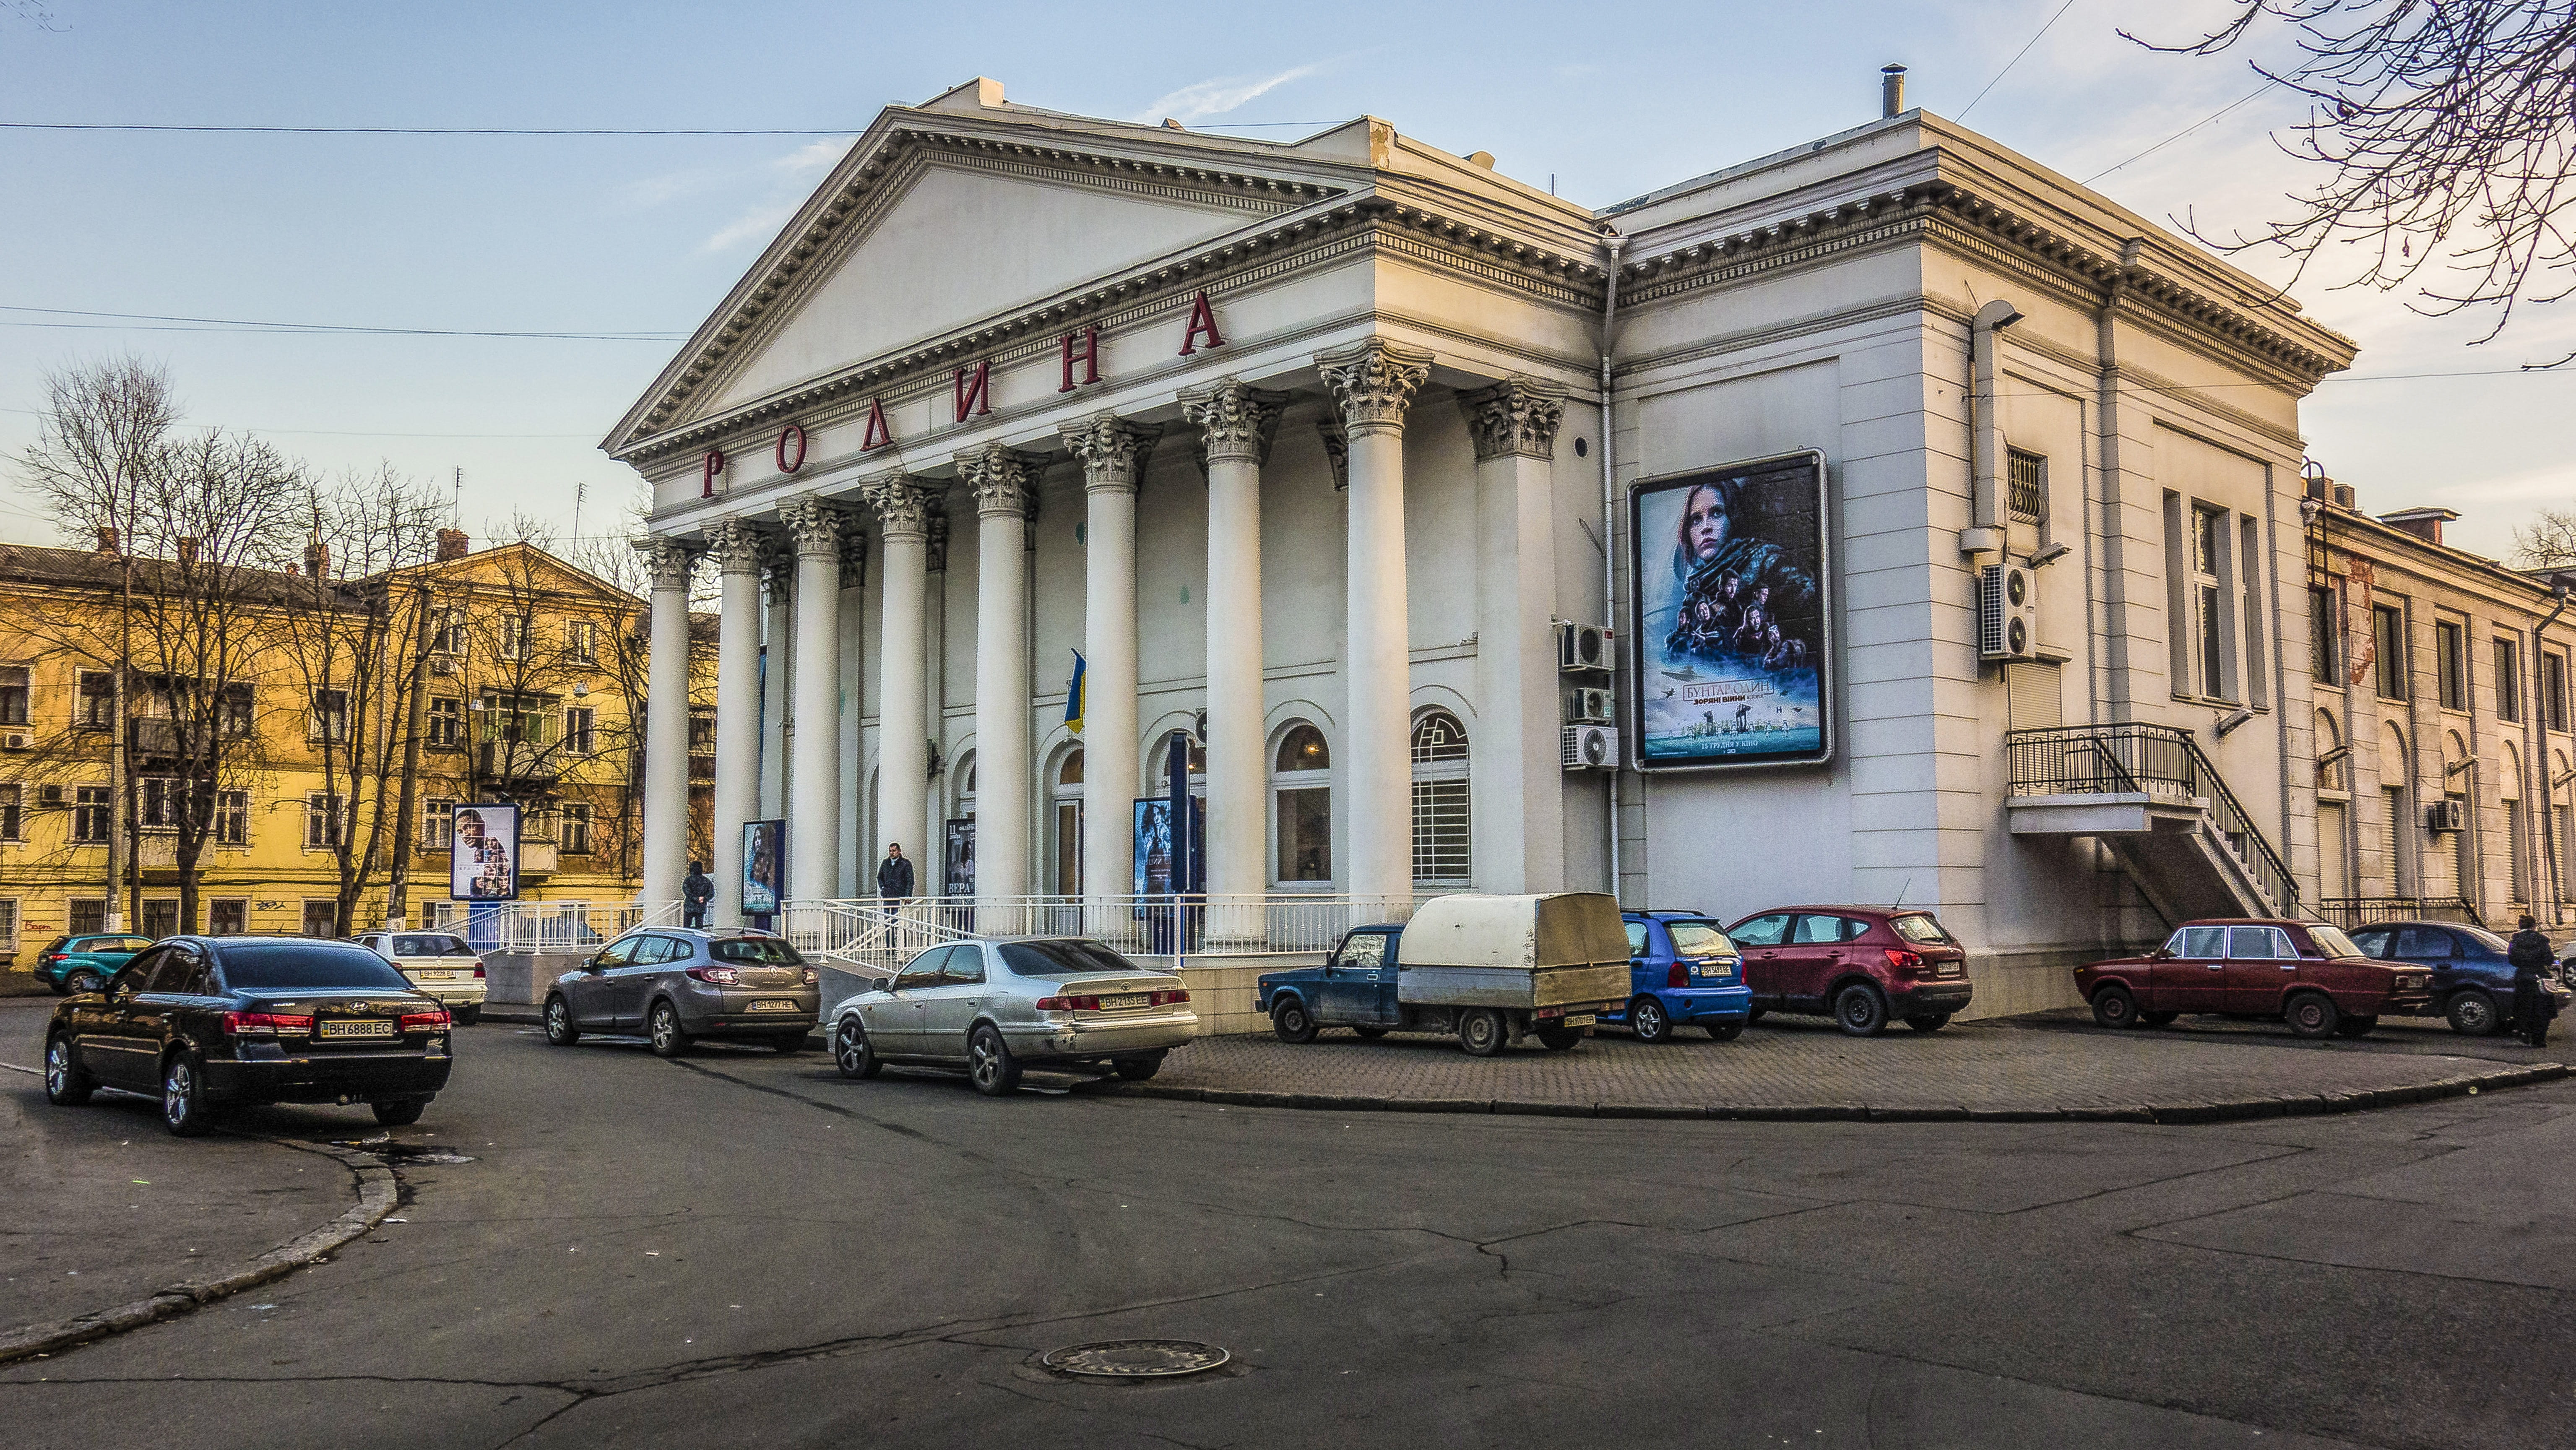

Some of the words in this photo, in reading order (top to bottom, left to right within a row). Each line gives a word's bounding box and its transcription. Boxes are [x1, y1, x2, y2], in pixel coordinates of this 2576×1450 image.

[701, 290, 1226, 498] РОДИНА
[1687, 684, 1730, 698] БУНТАР
[1733, 681, 1770, 694] ОДИН
[1694, 697, 1721, 705] ЗОРЯНІ
[949, 883, 970, 893] ВЕРА
[348, 1023, 372, 1034] 6888
